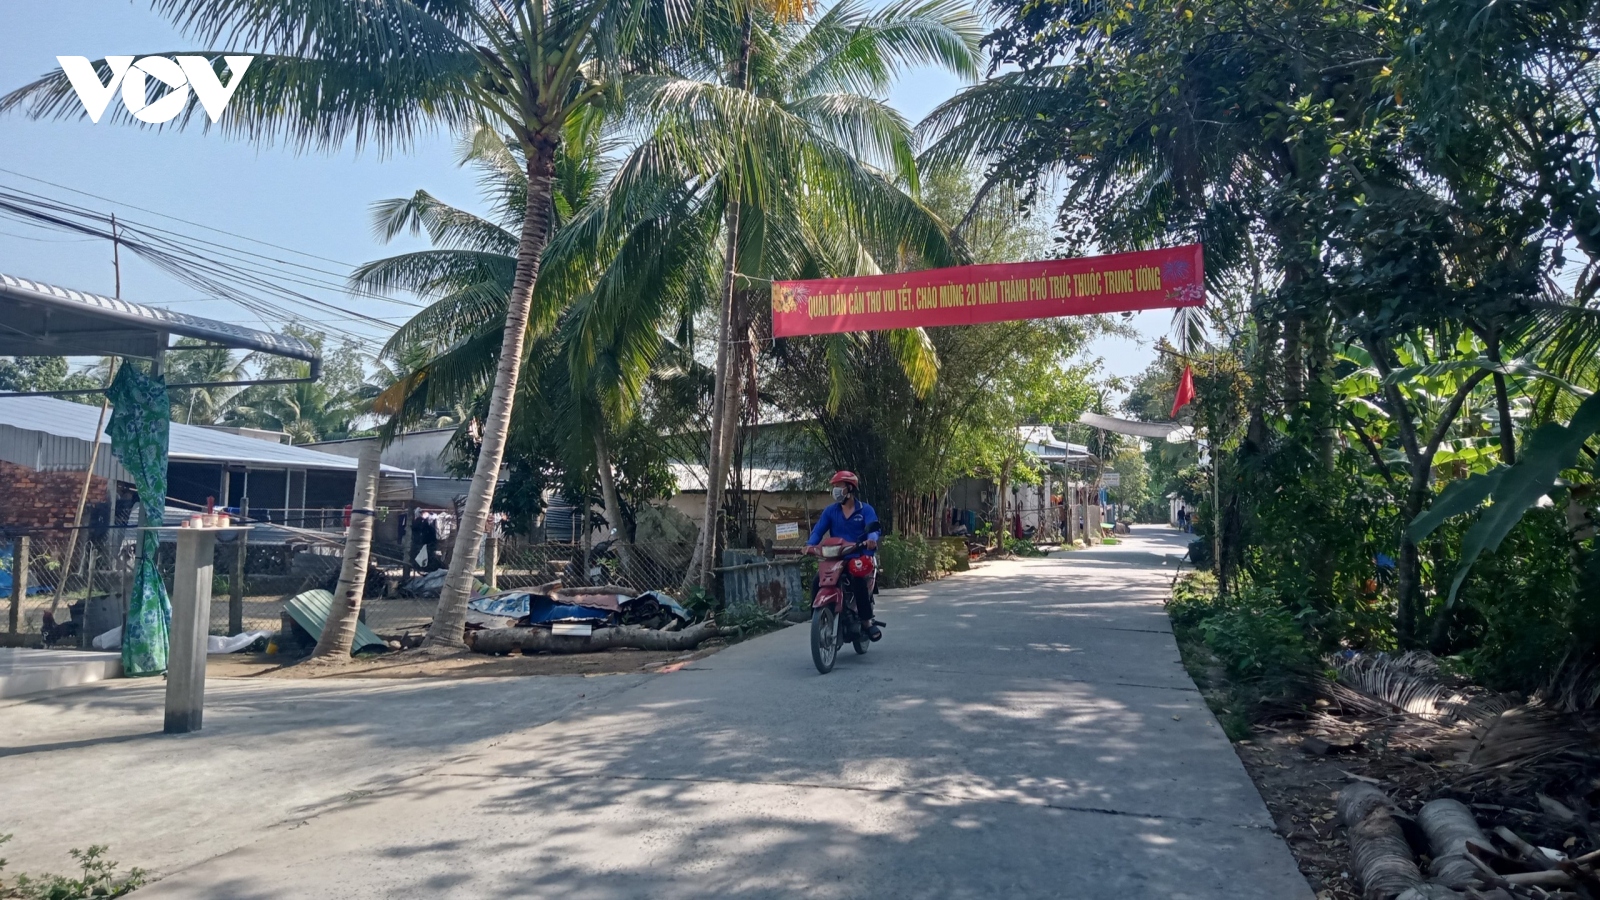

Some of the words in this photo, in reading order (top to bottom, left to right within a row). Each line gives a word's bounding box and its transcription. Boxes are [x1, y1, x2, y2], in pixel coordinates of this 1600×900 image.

[808, 291, 829, 320] QUÂN
[831, 289, 846, 316] DÂN
[866, 288, 882, 313] THƠ
[883, 290, 896, 312] VUI
[916, 282, 937, 310] CHÀO
[939, 280, 964, 308] MỪNG
[966, 283, 976, 306] 20
[978, 278, 998, 305] NĂM
[1000, 275, 1027, 302] THÀNH
[1030, 270, 1047, 300] PHỐ
[1049, 272, 1071, 303] TRỰC
[1073, 268, 1102, 301] THUỘC
[1103, 269, 1133, 294] TRUNG
[1136, 264, 1161, 291] ƯƠNG
